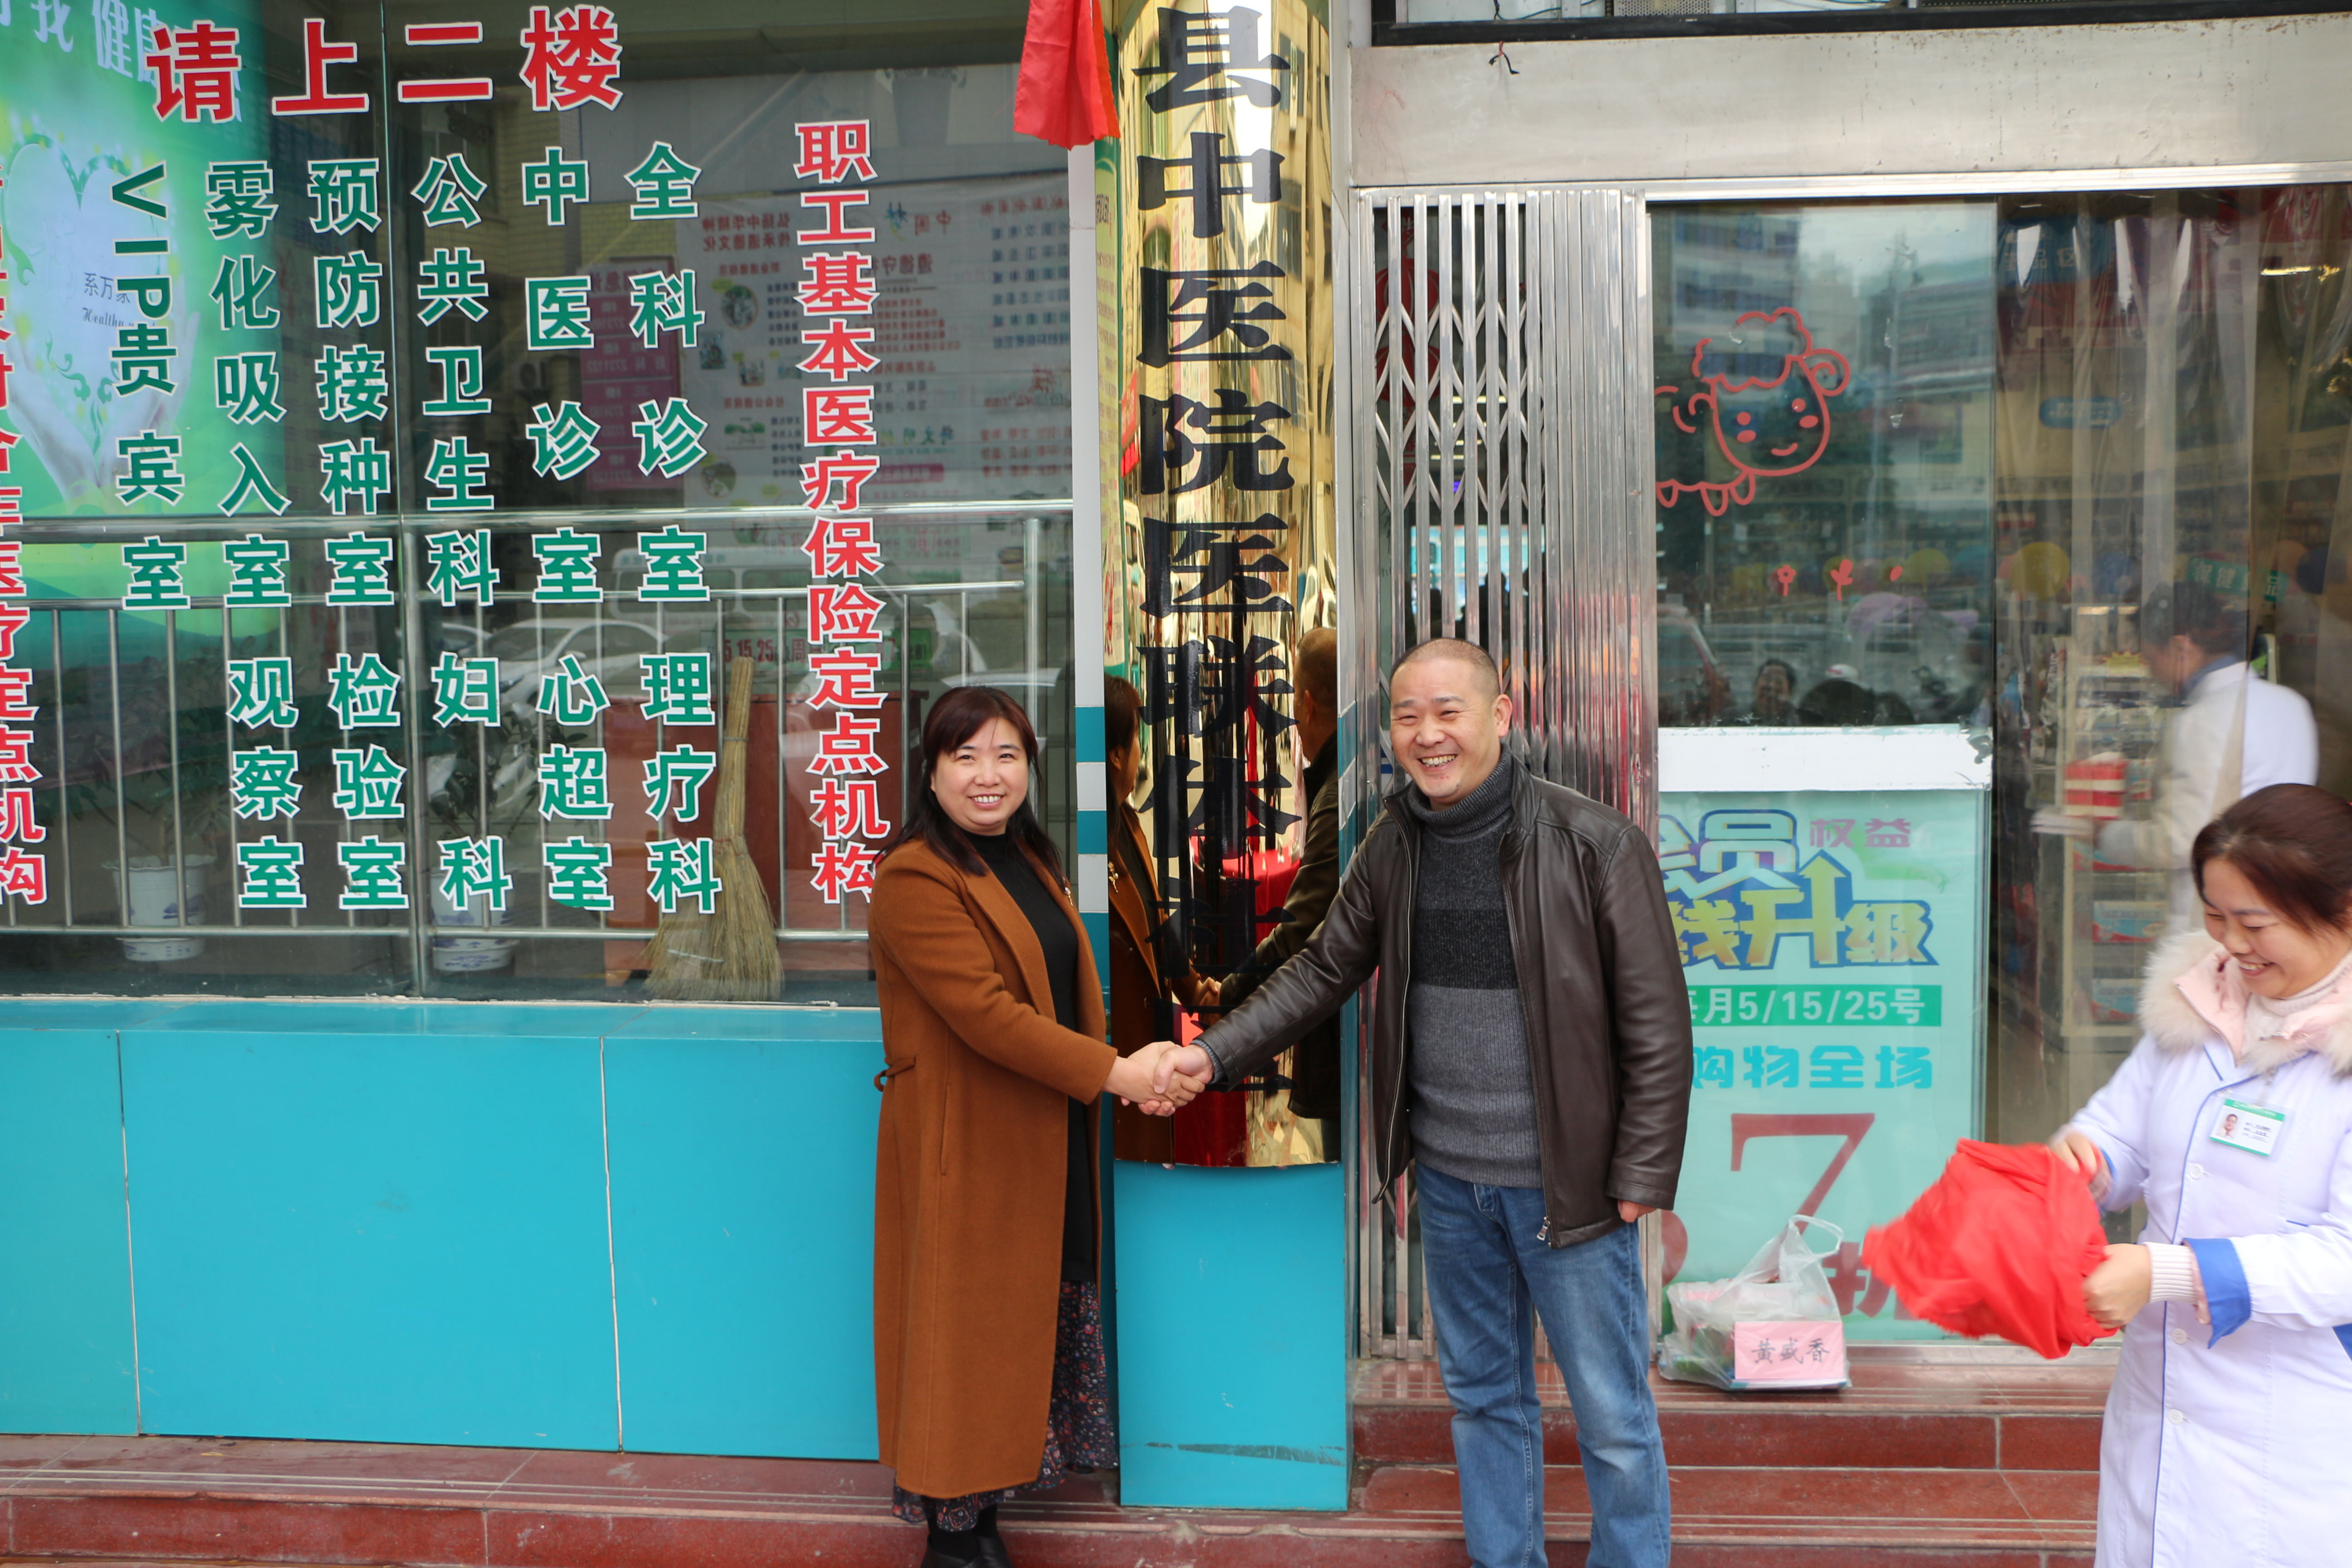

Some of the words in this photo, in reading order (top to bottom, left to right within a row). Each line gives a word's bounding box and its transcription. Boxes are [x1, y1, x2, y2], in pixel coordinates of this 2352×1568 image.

[144, 5, 623, 123] 请上二楼
[110, 161, 191, 610] VIP贵宾室
[204, 160, 292, 608] 雾化吸入室
[308, 158, 395, 606] 预防接种室
[410, 153, 500, 607] 公共卫生科
[522, 147, 604, 603] 中医诊室
[624, 141, 710, 602] 全科诊室
[793, 119, 891, 904] 职工基本医疗保险定点机构
[226, 657, 308, 909] 观察室
[328, 653, 410, 909] 检验室
[431, 651, 513, 911] 妇科
[536, 654, 615, 911] 心超室
[640, 652, 723, 914] 理疗科
[1809, 818, 1912, 848] 权益
[1692, 1045, 1933, 1089] 购物全场
